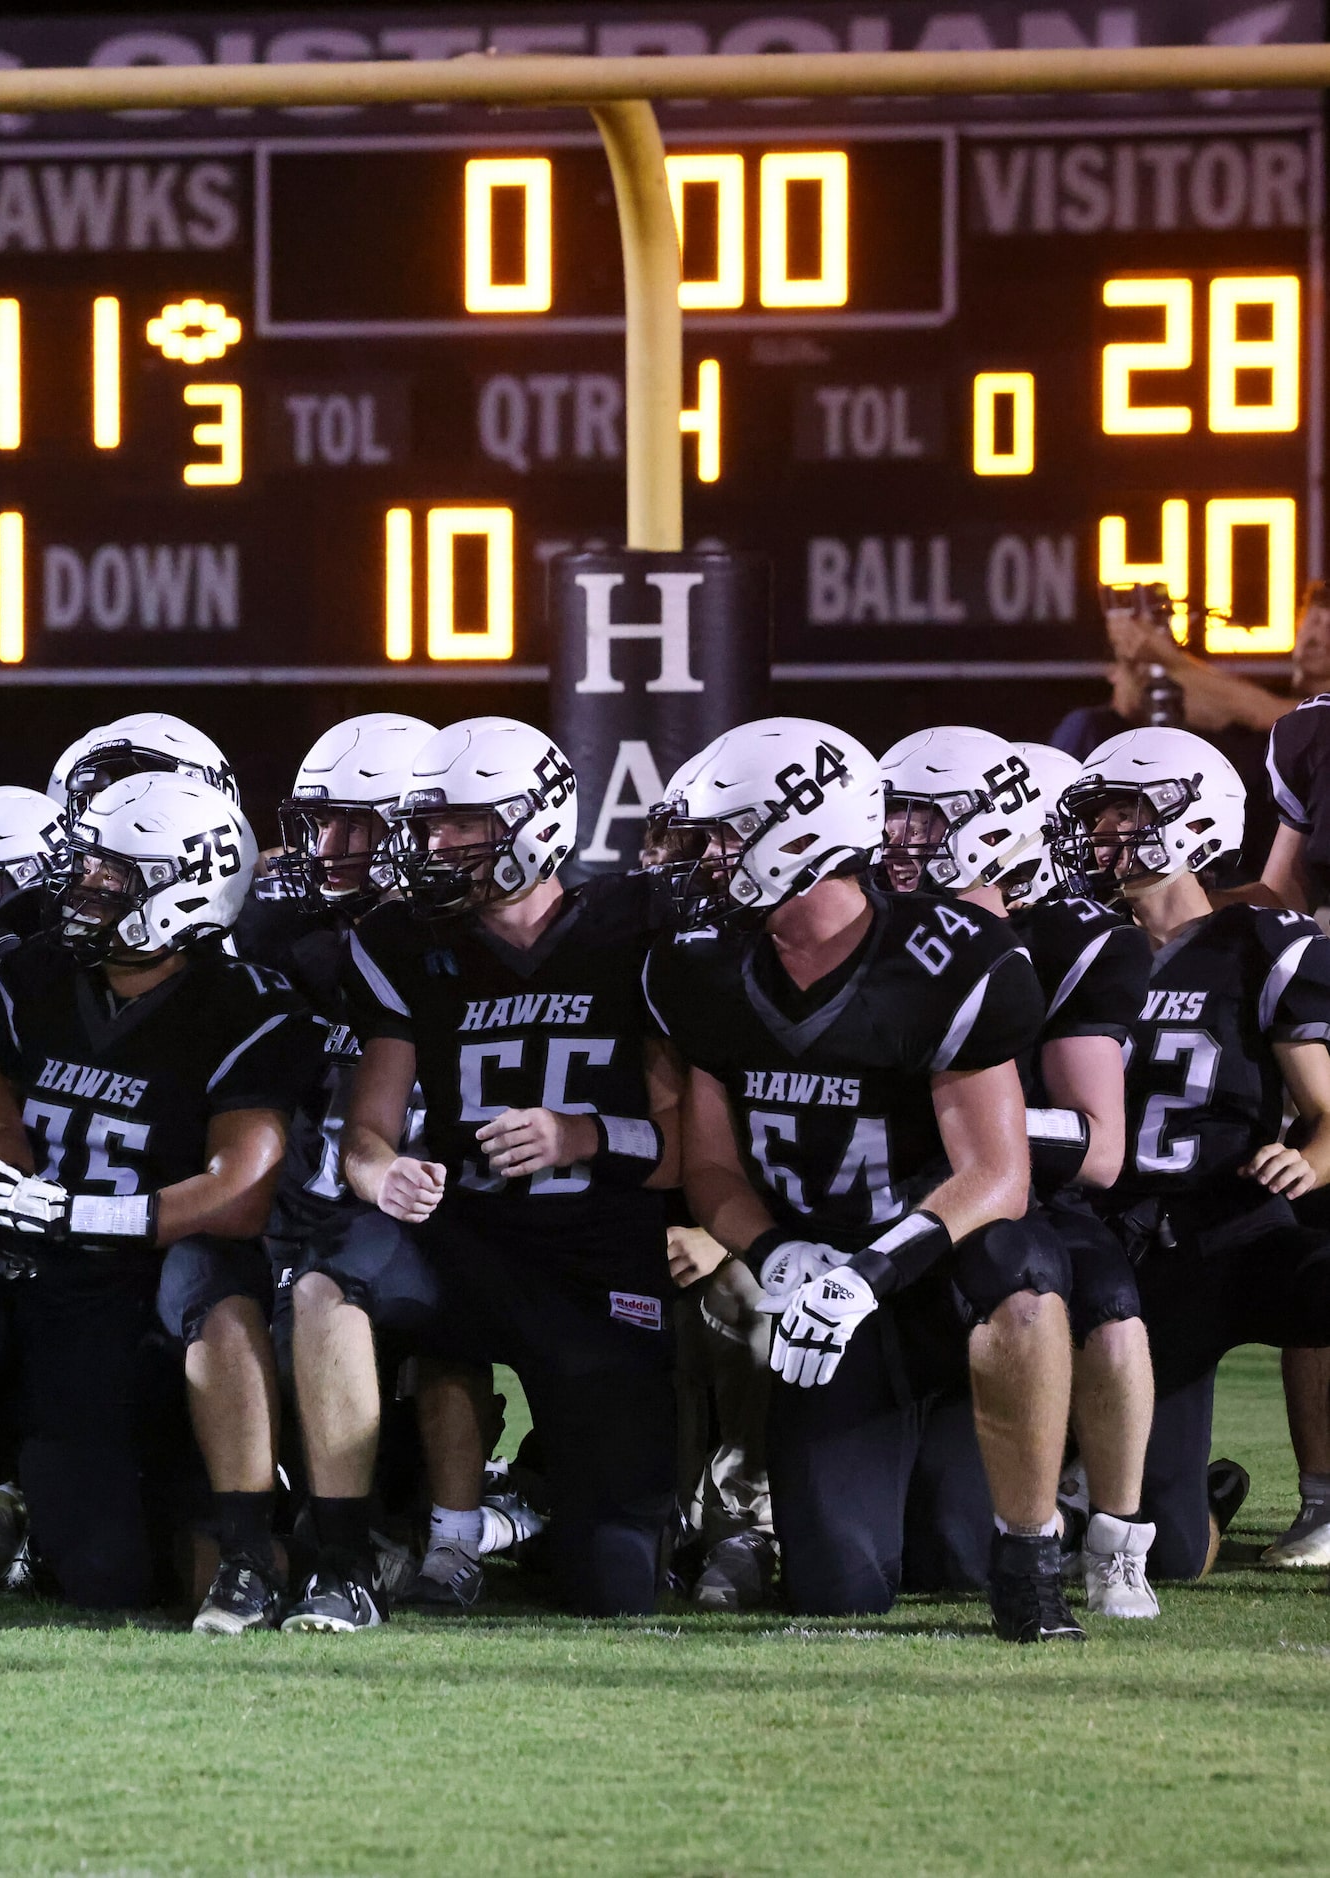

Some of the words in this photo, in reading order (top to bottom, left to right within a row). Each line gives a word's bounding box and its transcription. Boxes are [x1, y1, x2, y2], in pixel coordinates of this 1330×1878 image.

[974, 143, 1310, 234] VISITOR
[1102, 274, 1301, 437] 28
[183, 383, 243, 486] 3
[287, 394, 389, 466] TOL
[478, 372, 622, 474] QTR
[817, 387, 923, 460] TOL
[973, 372, 1036, 477] 0
[43, 544, 241, 631] DOWN
[384, 506, 515, 661] 10
[808, 538, 967, 624] BALL
[987, 535, 1074, 620] ON
[1099, 497, 1297, 655] 40
[775, 745, 852, 816] 64
[982, 756, 1041, 815] 52
[182, 825, 241, 890] 75
[905, 904, 982, 977] 64
[456, 992, 593, 1031] HAWKS
[35, 1058, 148, 1108] HAWKS
[743, 1070, 861, 1107] HAWKS
[1122, 1030, 1222, 1175] 2
[22, 1098, 152, 1197] 75
[615, 1296, 657, 1314] Riddell
